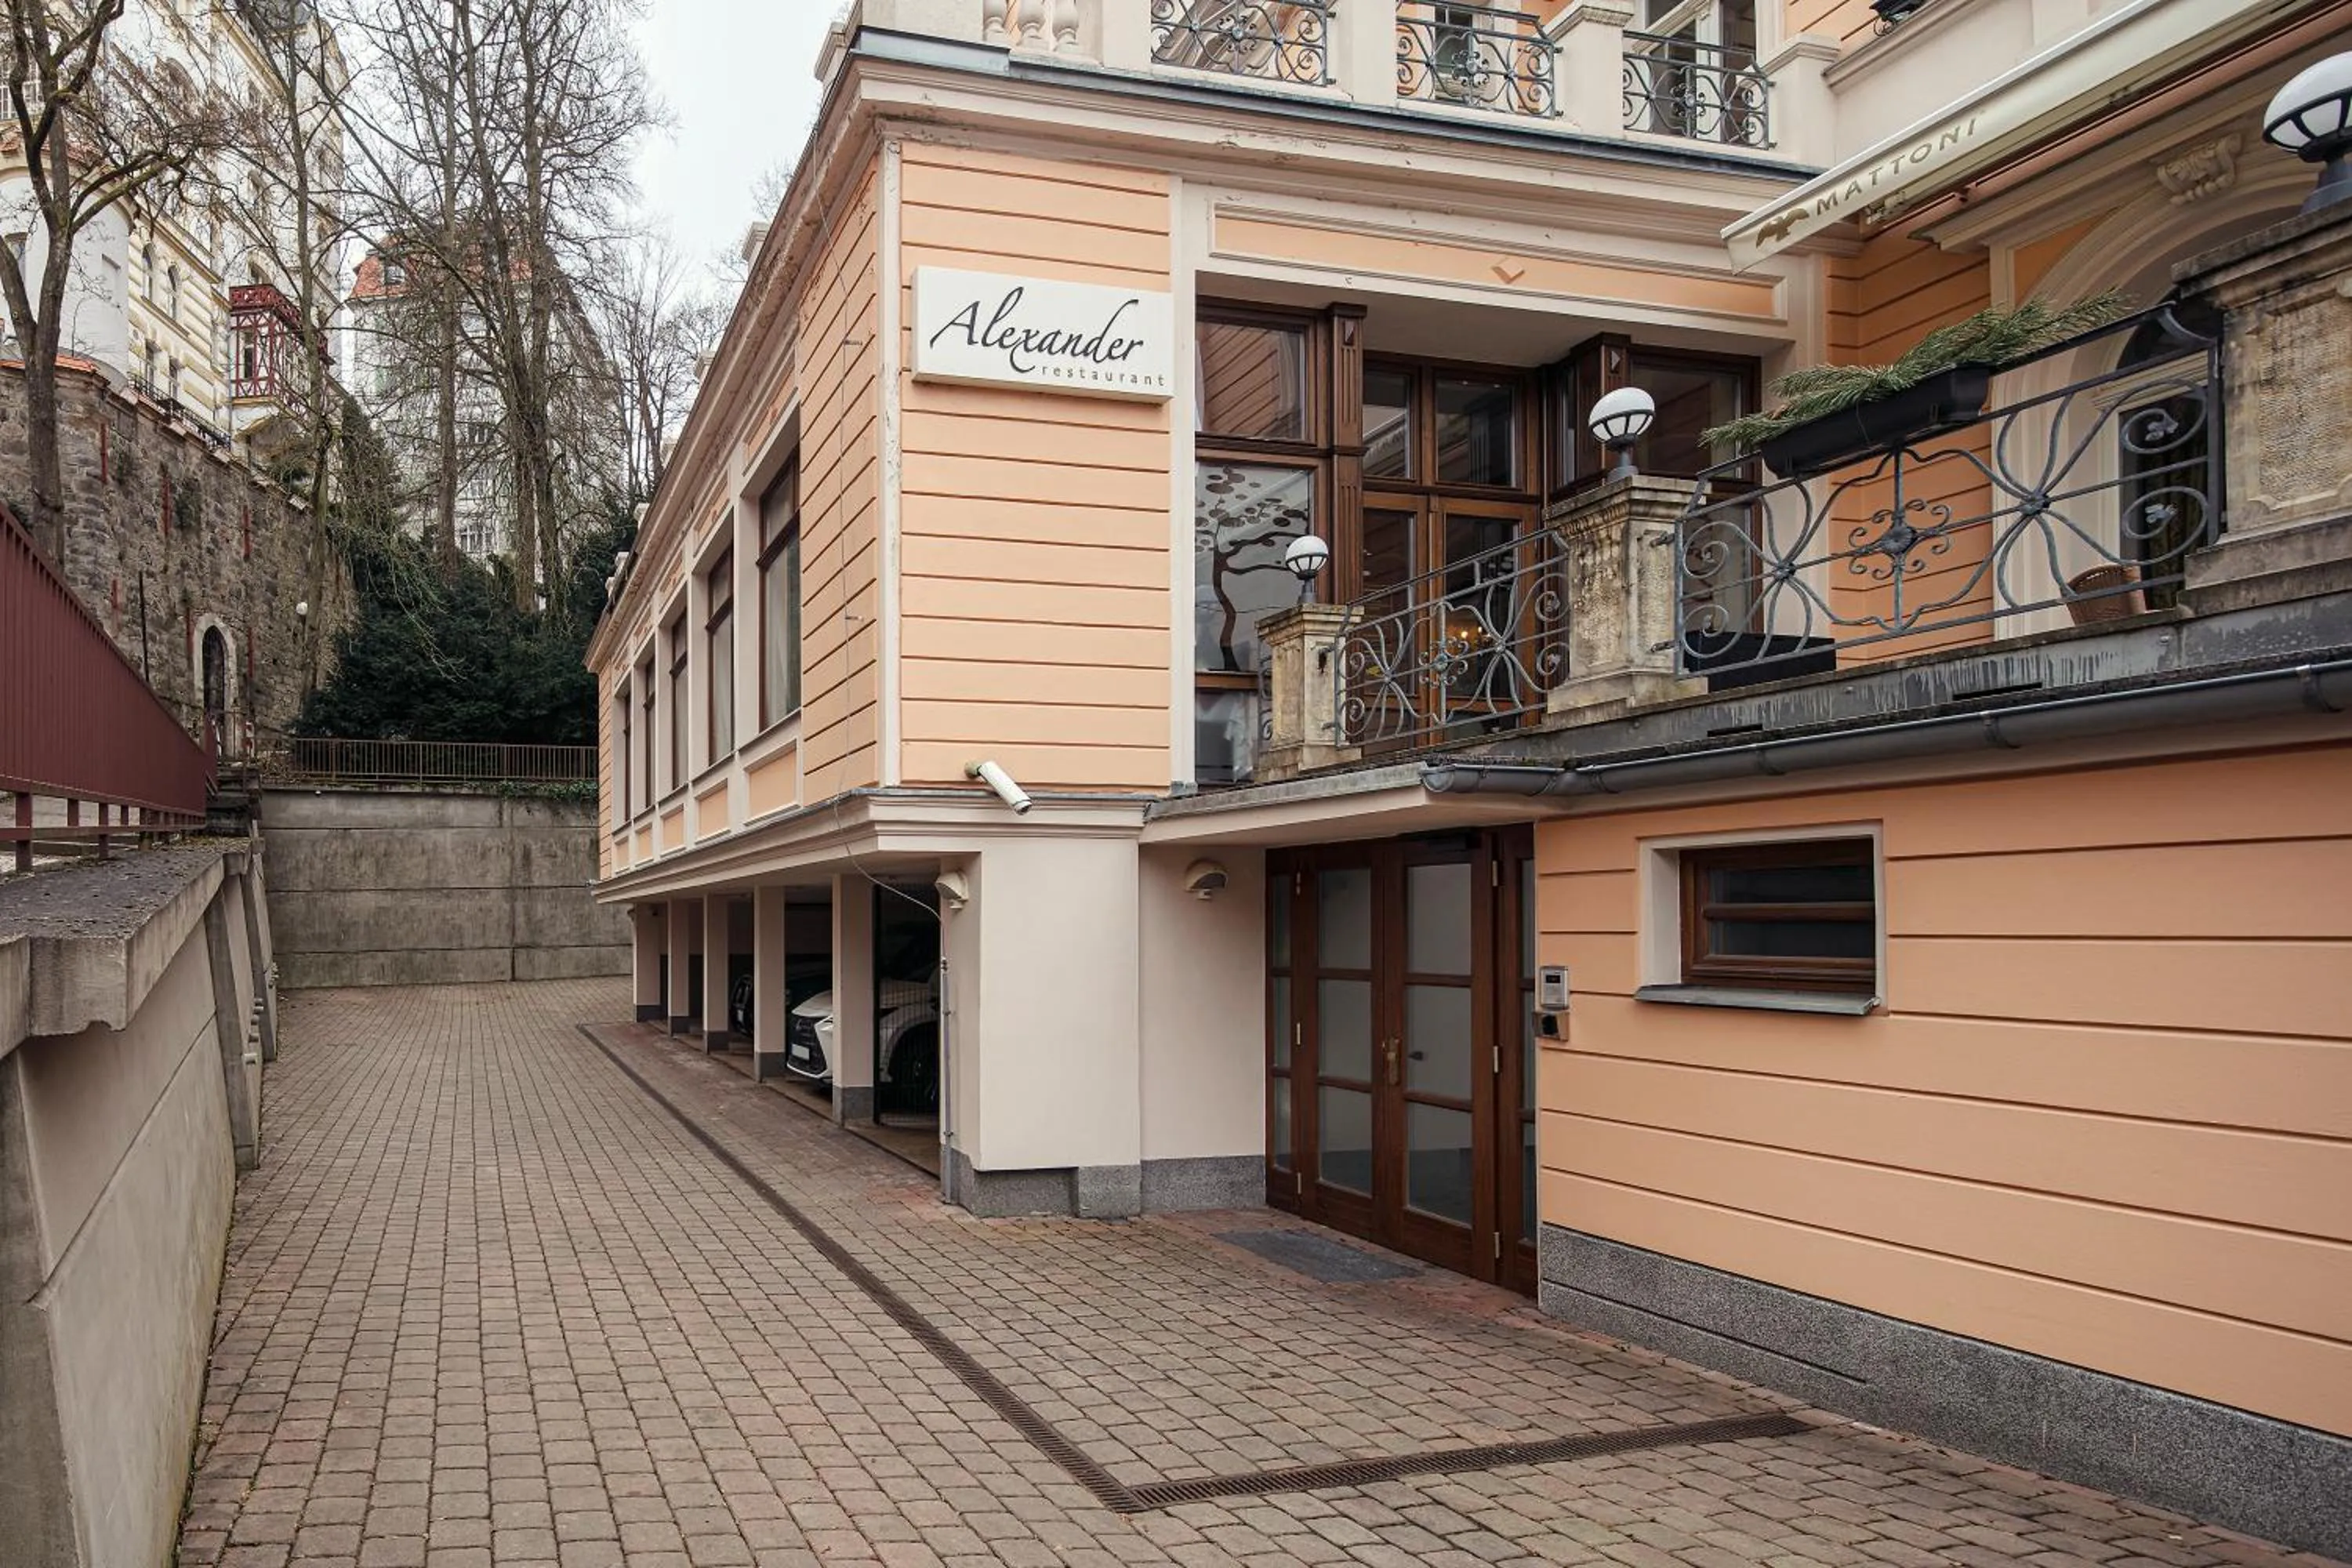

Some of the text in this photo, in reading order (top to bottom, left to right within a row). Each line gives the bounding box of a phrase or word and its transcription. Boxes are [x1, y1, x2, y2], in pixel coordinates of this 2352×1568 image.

[1816, 118, 1976, 216] MATTONI
[930, 287, 1144, 373] Alexander
[1042, 365, 1165, 387] restaurant
